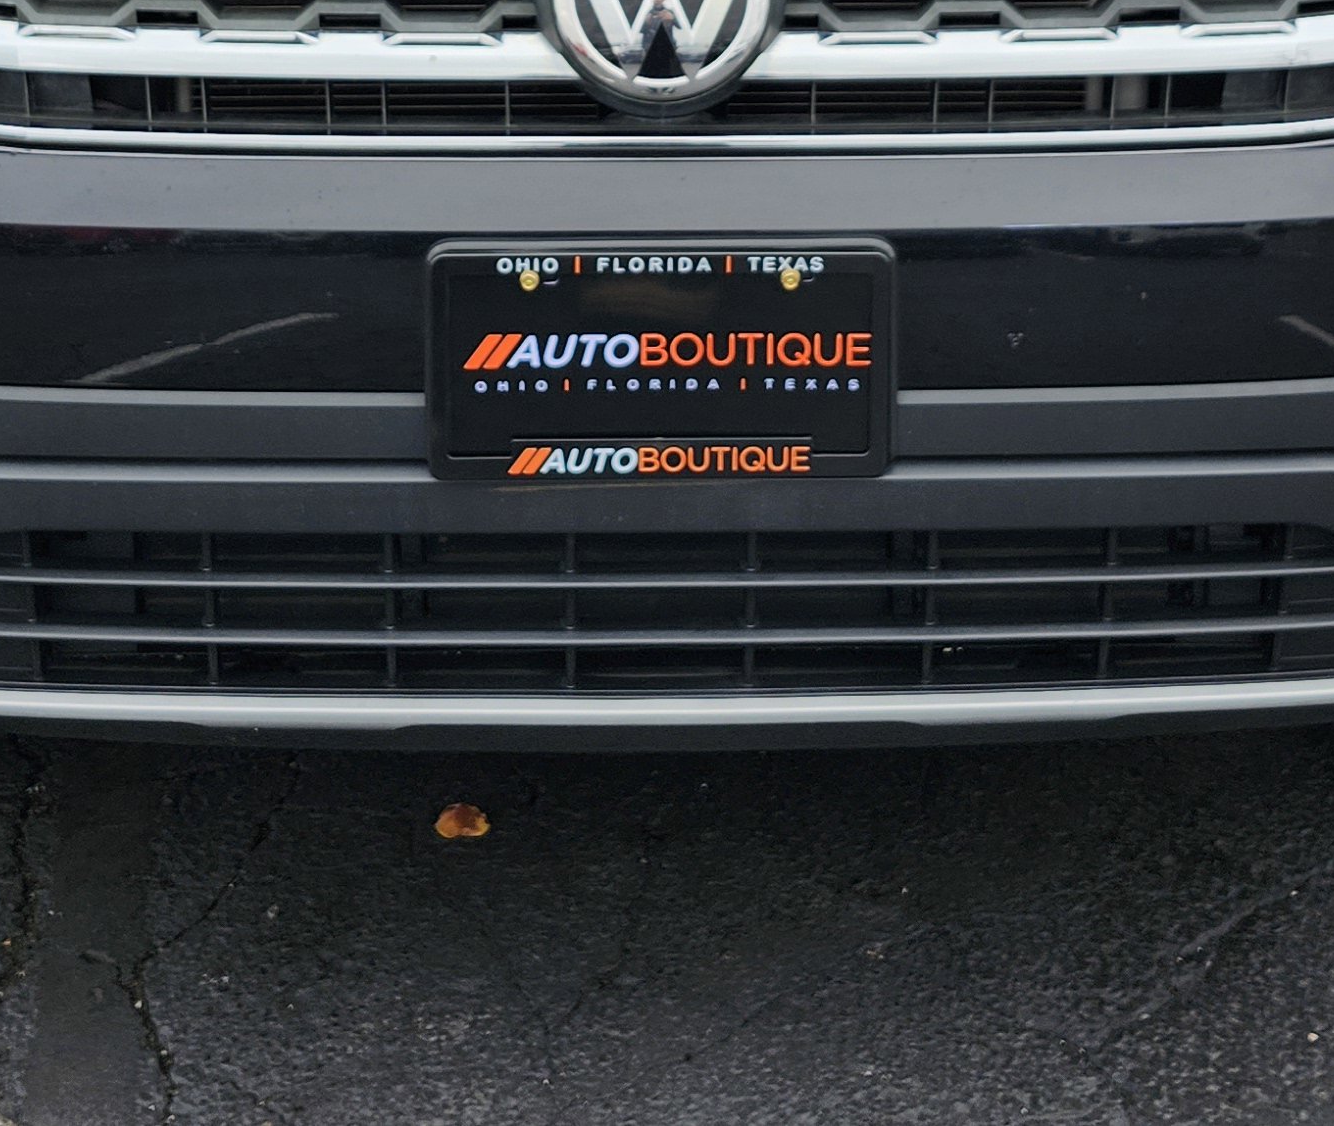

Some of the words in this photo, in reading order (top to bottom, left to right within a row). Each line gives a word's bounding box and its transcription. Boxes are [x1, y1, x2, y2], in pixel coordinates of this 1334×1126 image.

[496, 257, 560, 274] OHIO
[596, 256, 712, 274] FLORIDA
[747, 256, 825, 273] TEXAS
[505, 333, 873, 369] AUTOBOUTIQUE
[474, 379, 549, 394] OHIO
[586, 378, 721, 392] FLORIDA
[764, 377, 861, 392] TEXAS
[539, 445, 812, 474] AUTOBOUTIQUE
